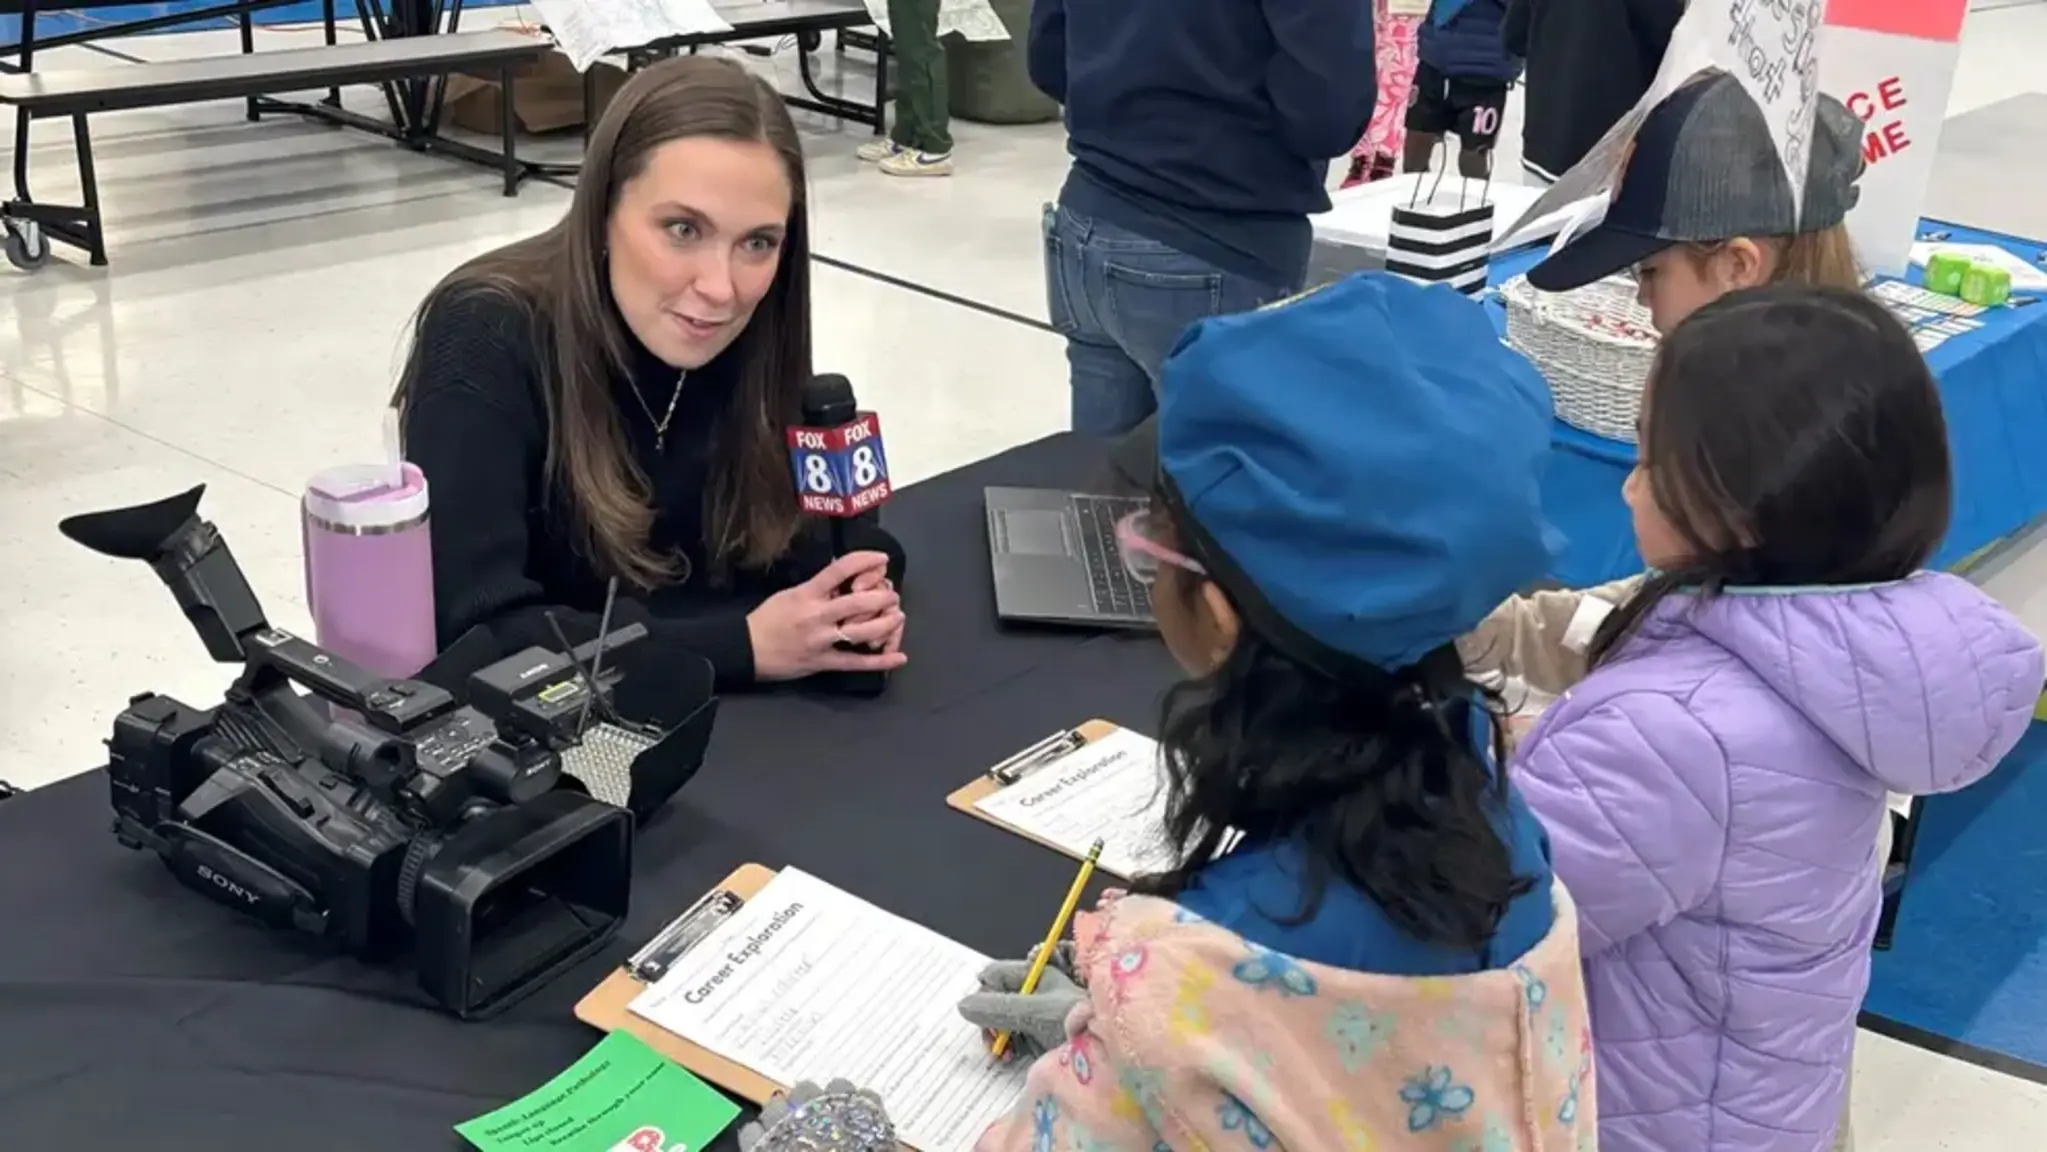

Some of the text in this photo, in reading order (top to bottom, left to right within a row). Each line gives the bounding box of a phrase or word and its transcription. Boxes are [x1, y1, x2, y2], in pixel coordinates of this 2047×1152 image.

[1472, 105, 1498, 135] 10
[796, 430, 827, 449] FOX
[844, 420, 872, 446] FOX
[805, 454, 832, 493] 8
[852, 445, 877, 487] 8
[804, 495, 844, 513] NEWS
[851, 483, 888, 509] NEWS
[1020, 783, 1063, 807] Career
[1061, 749, 1127, 788] Exploration
[197, 864, 261, 904] SONY
[684, 963, 735, 1004] Career
[727, 901, 804, 965] Exploration
[586, 1097, 624, 1124] through
[623, 1080, 645, 1099] your
